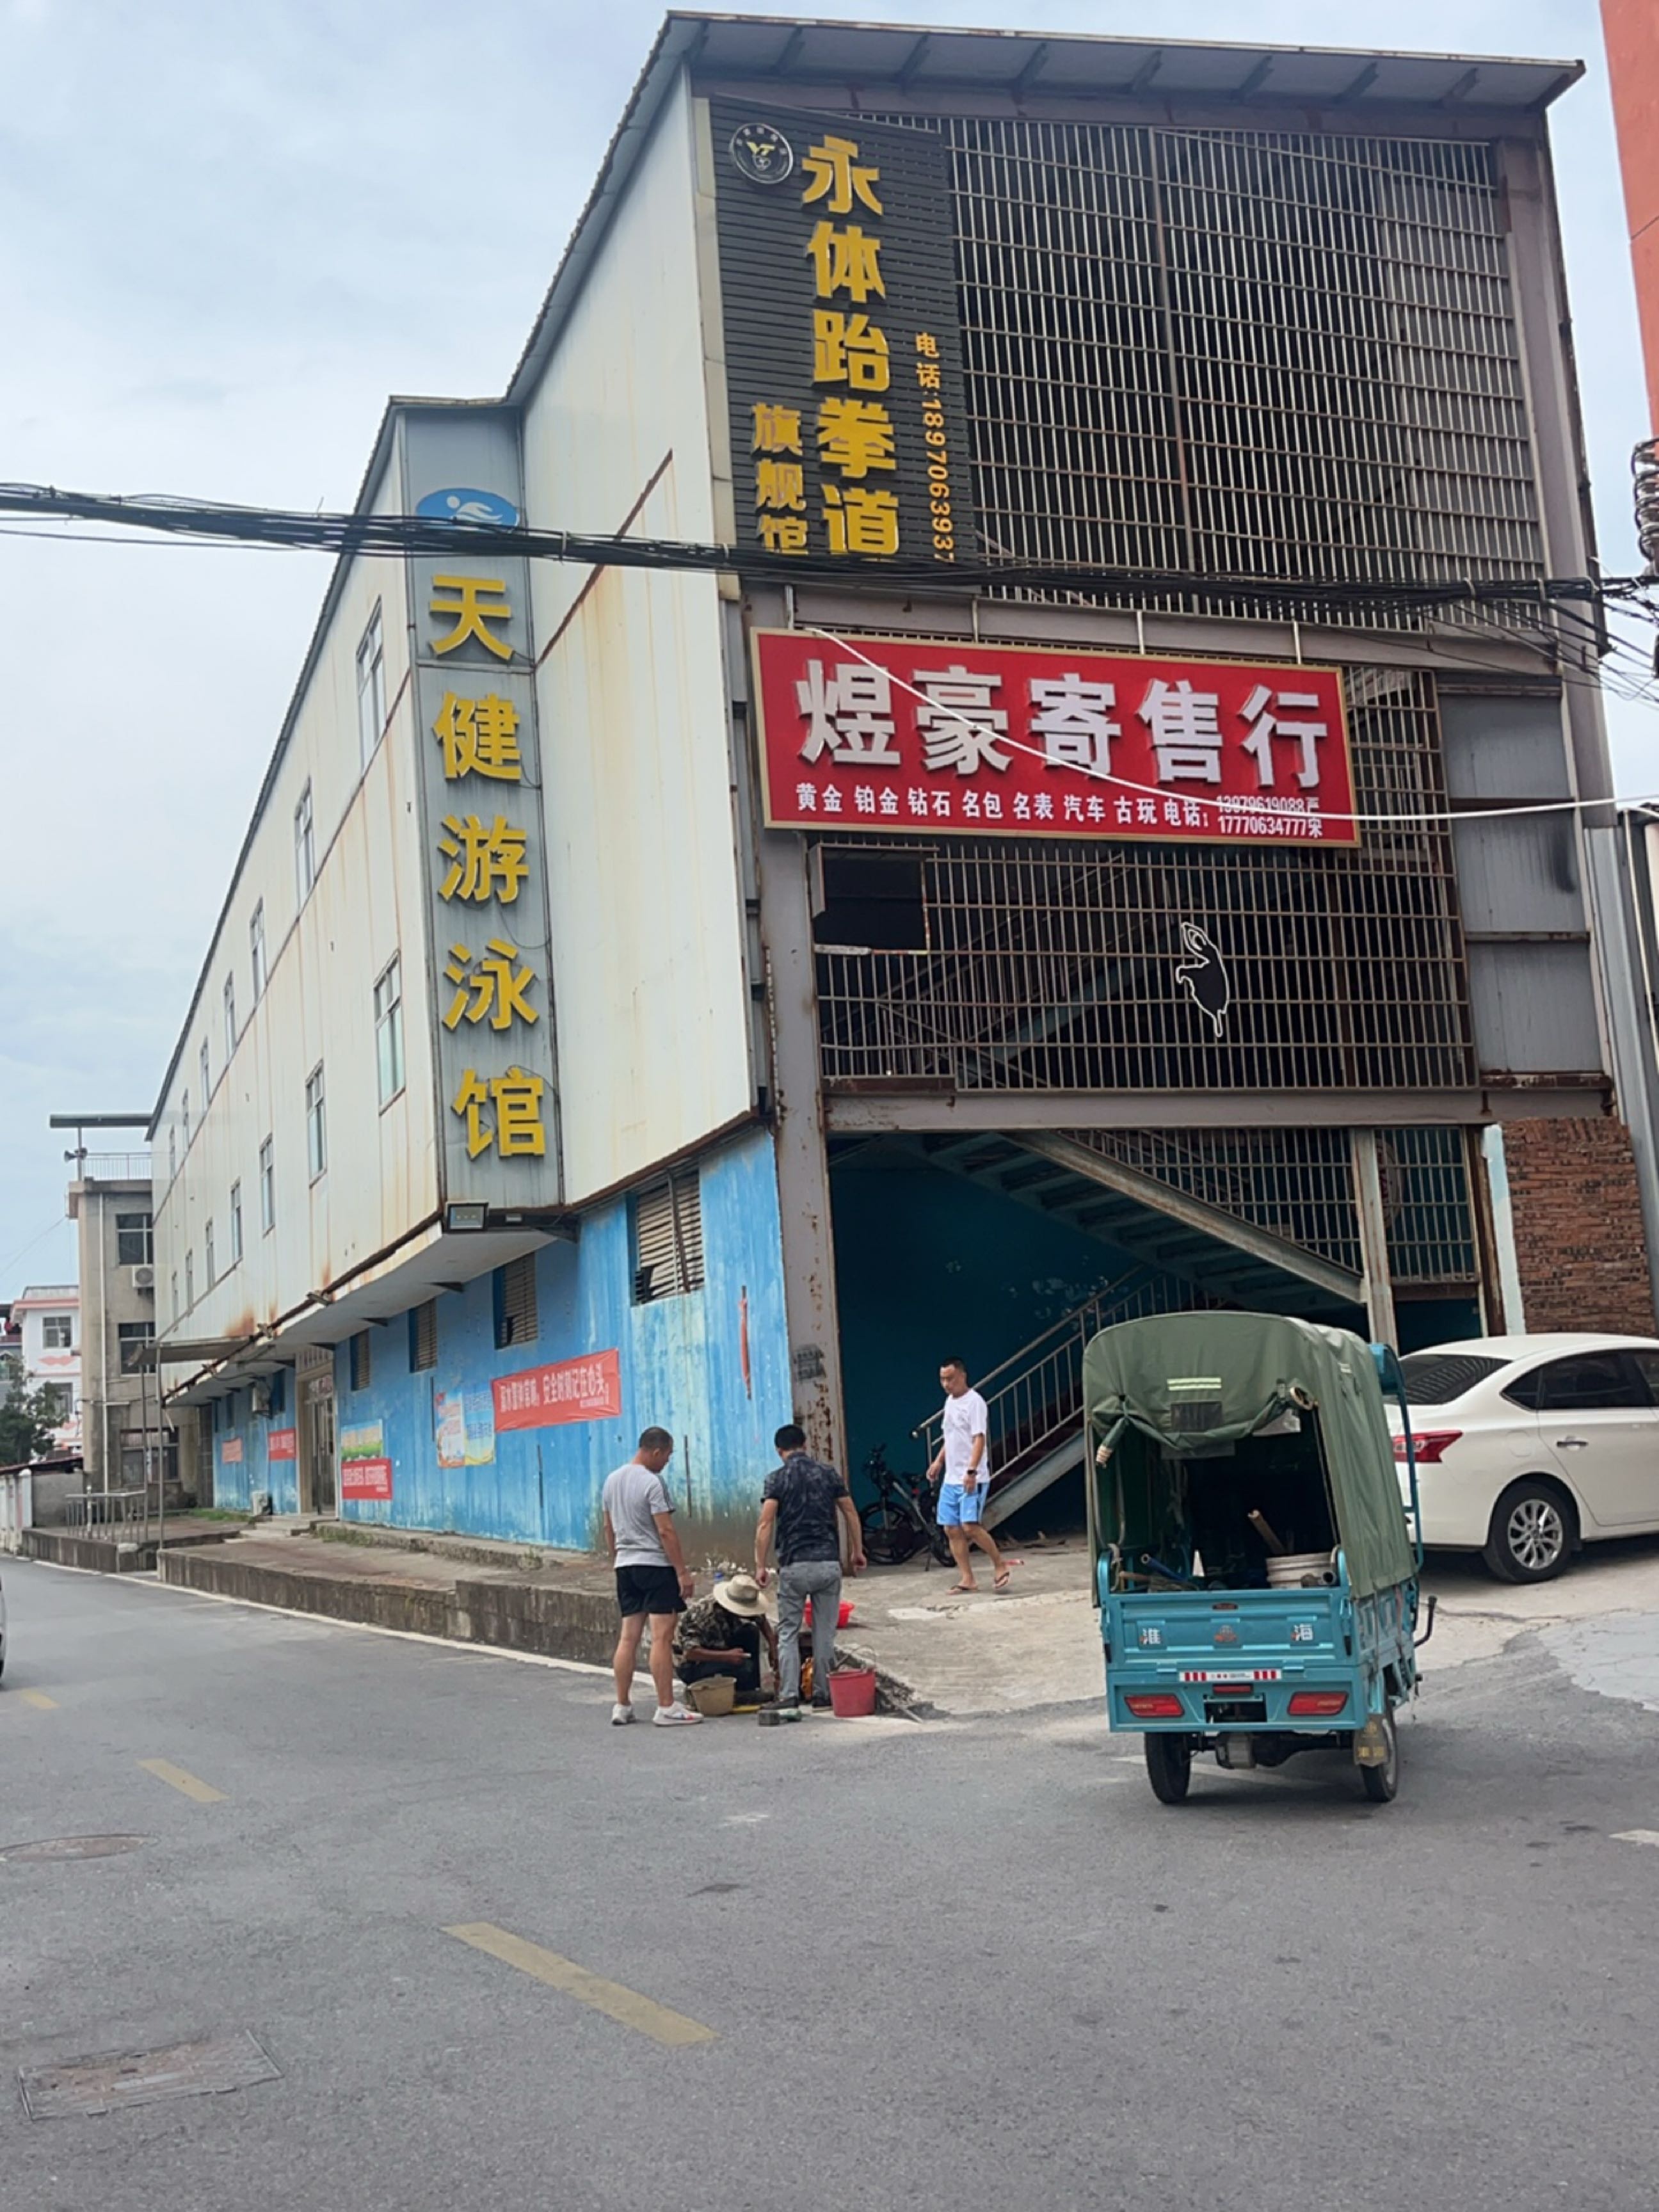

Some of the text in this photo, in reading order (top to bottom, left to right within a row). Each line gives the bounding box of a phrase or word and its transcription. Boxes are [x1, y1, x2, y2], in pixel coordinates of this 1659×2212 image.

[802, 134, 899, 561] 永体跆拳道
[751, 402, 808, 556] 旗舰馆
[797, 659, 1327, 789] 煜豪寄售行
[428, 573, 546, 1160] 天健游泳馆
[796, 782, 842, 813] 黄金
[854, 785, 899, 815] 铂金
[908, 787, 950, 817] 钻石
[963, 789, 1004, 820] 名包
[1013, 791, 1054, 821] 名表
[1064, 794, 1105, 823] 汽车
[1114, 796, 1157, 824] 古玩
